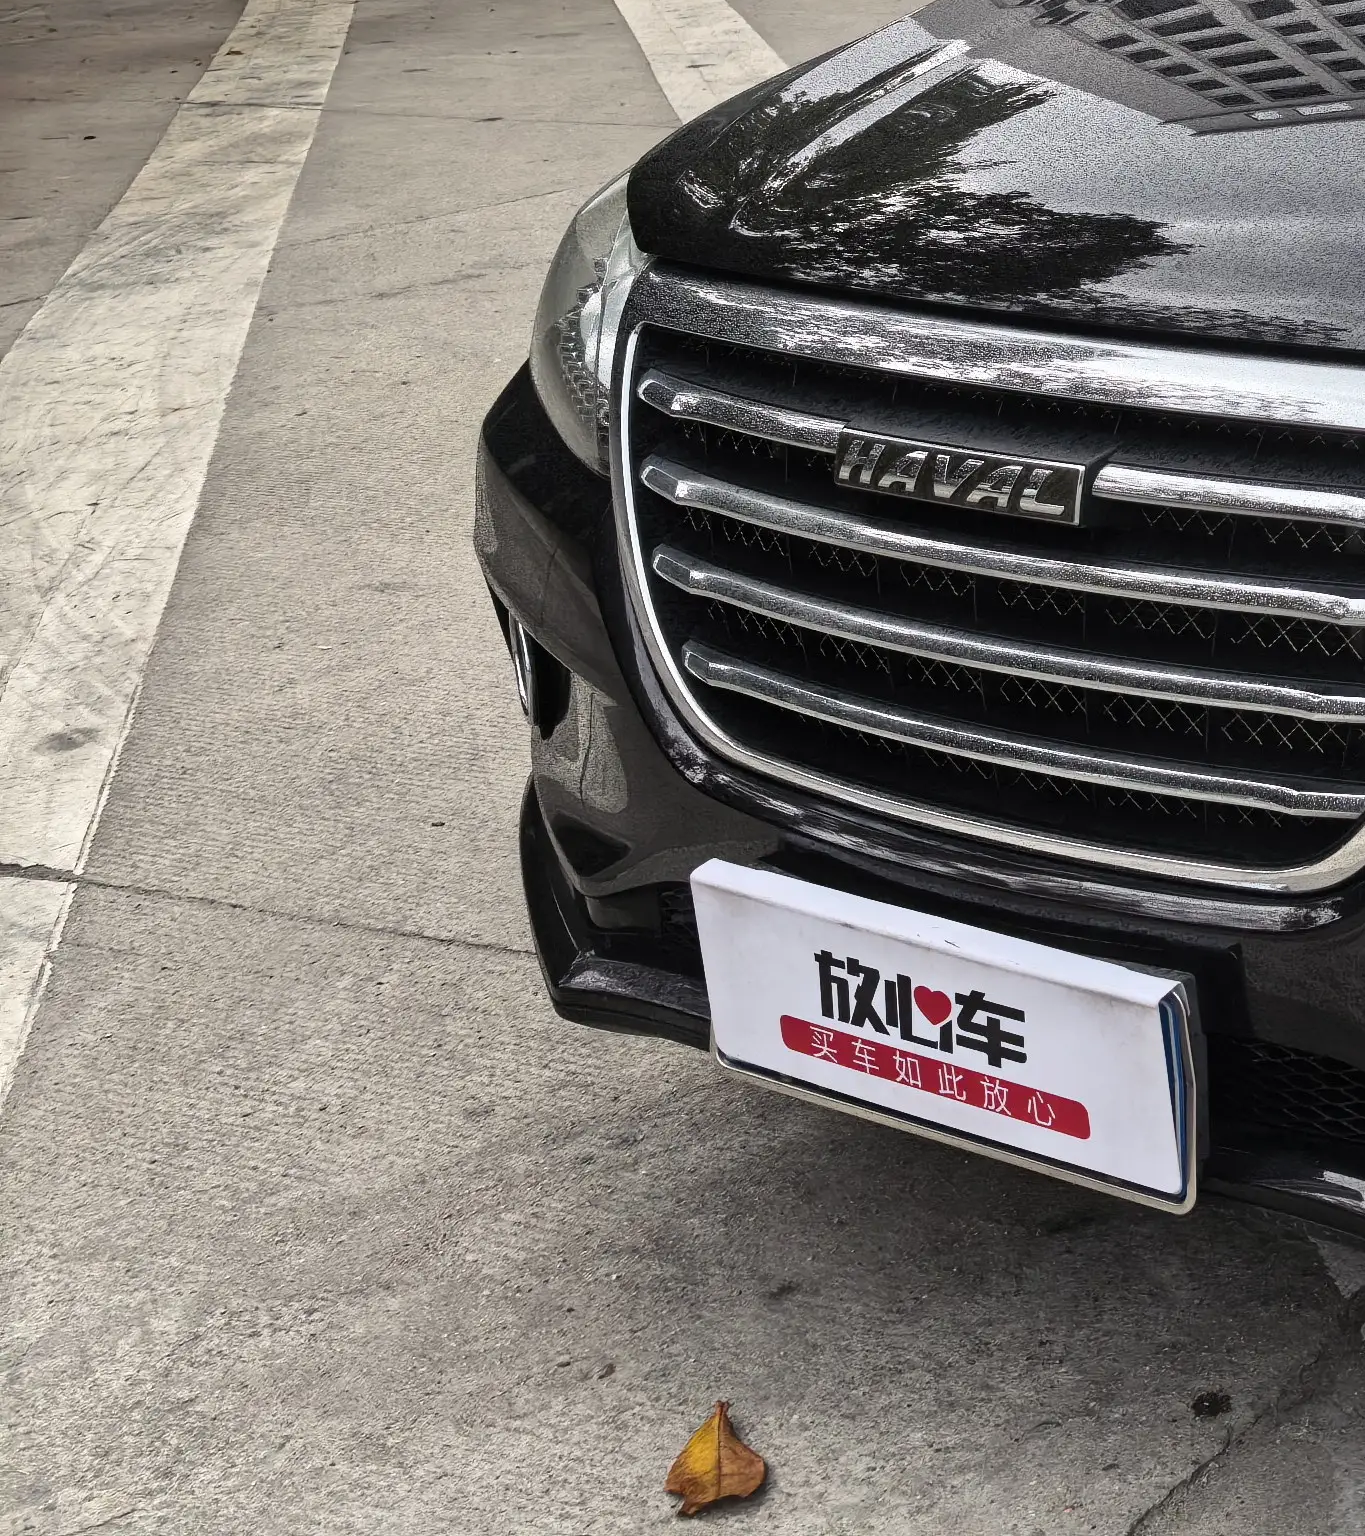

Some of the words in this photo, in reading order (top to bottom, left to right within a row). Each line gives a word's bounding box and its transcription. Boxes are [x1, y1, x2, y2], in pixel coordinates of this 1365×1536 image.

[839, 438, 1065, 516] HAVAL
[813, 949, 1028, 1069] 放心车
[809, 1025, 1056, 1127] 买车如此放心
